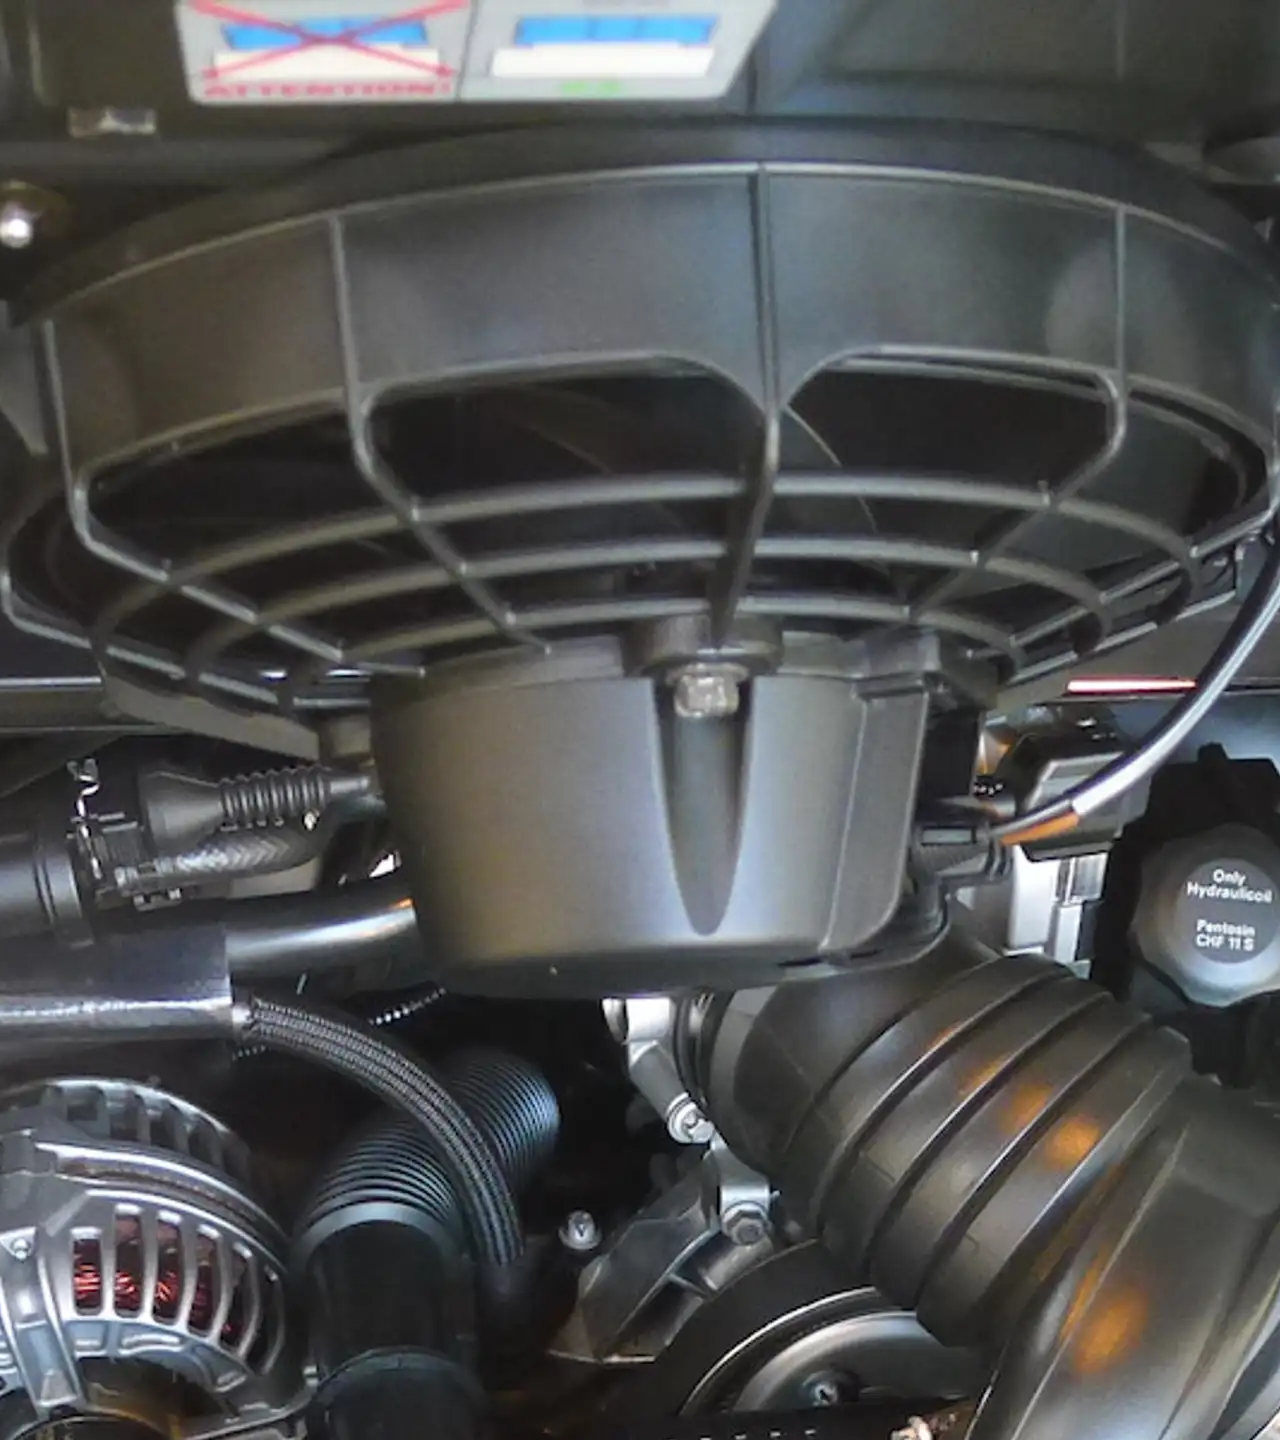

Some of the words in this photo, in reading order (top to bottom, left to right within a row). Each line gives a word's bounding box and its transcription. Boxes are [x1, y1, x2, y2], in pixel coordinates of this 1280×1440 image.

[1213, 868, 1246, 887] Only
[1186, 881, 1272, 903] Hydraulicoil
[1196, 919, 1255, 938] Pentosin
[1196, 933, 1223, 949] CHF
[1228, 936, 1241, 951] 11
